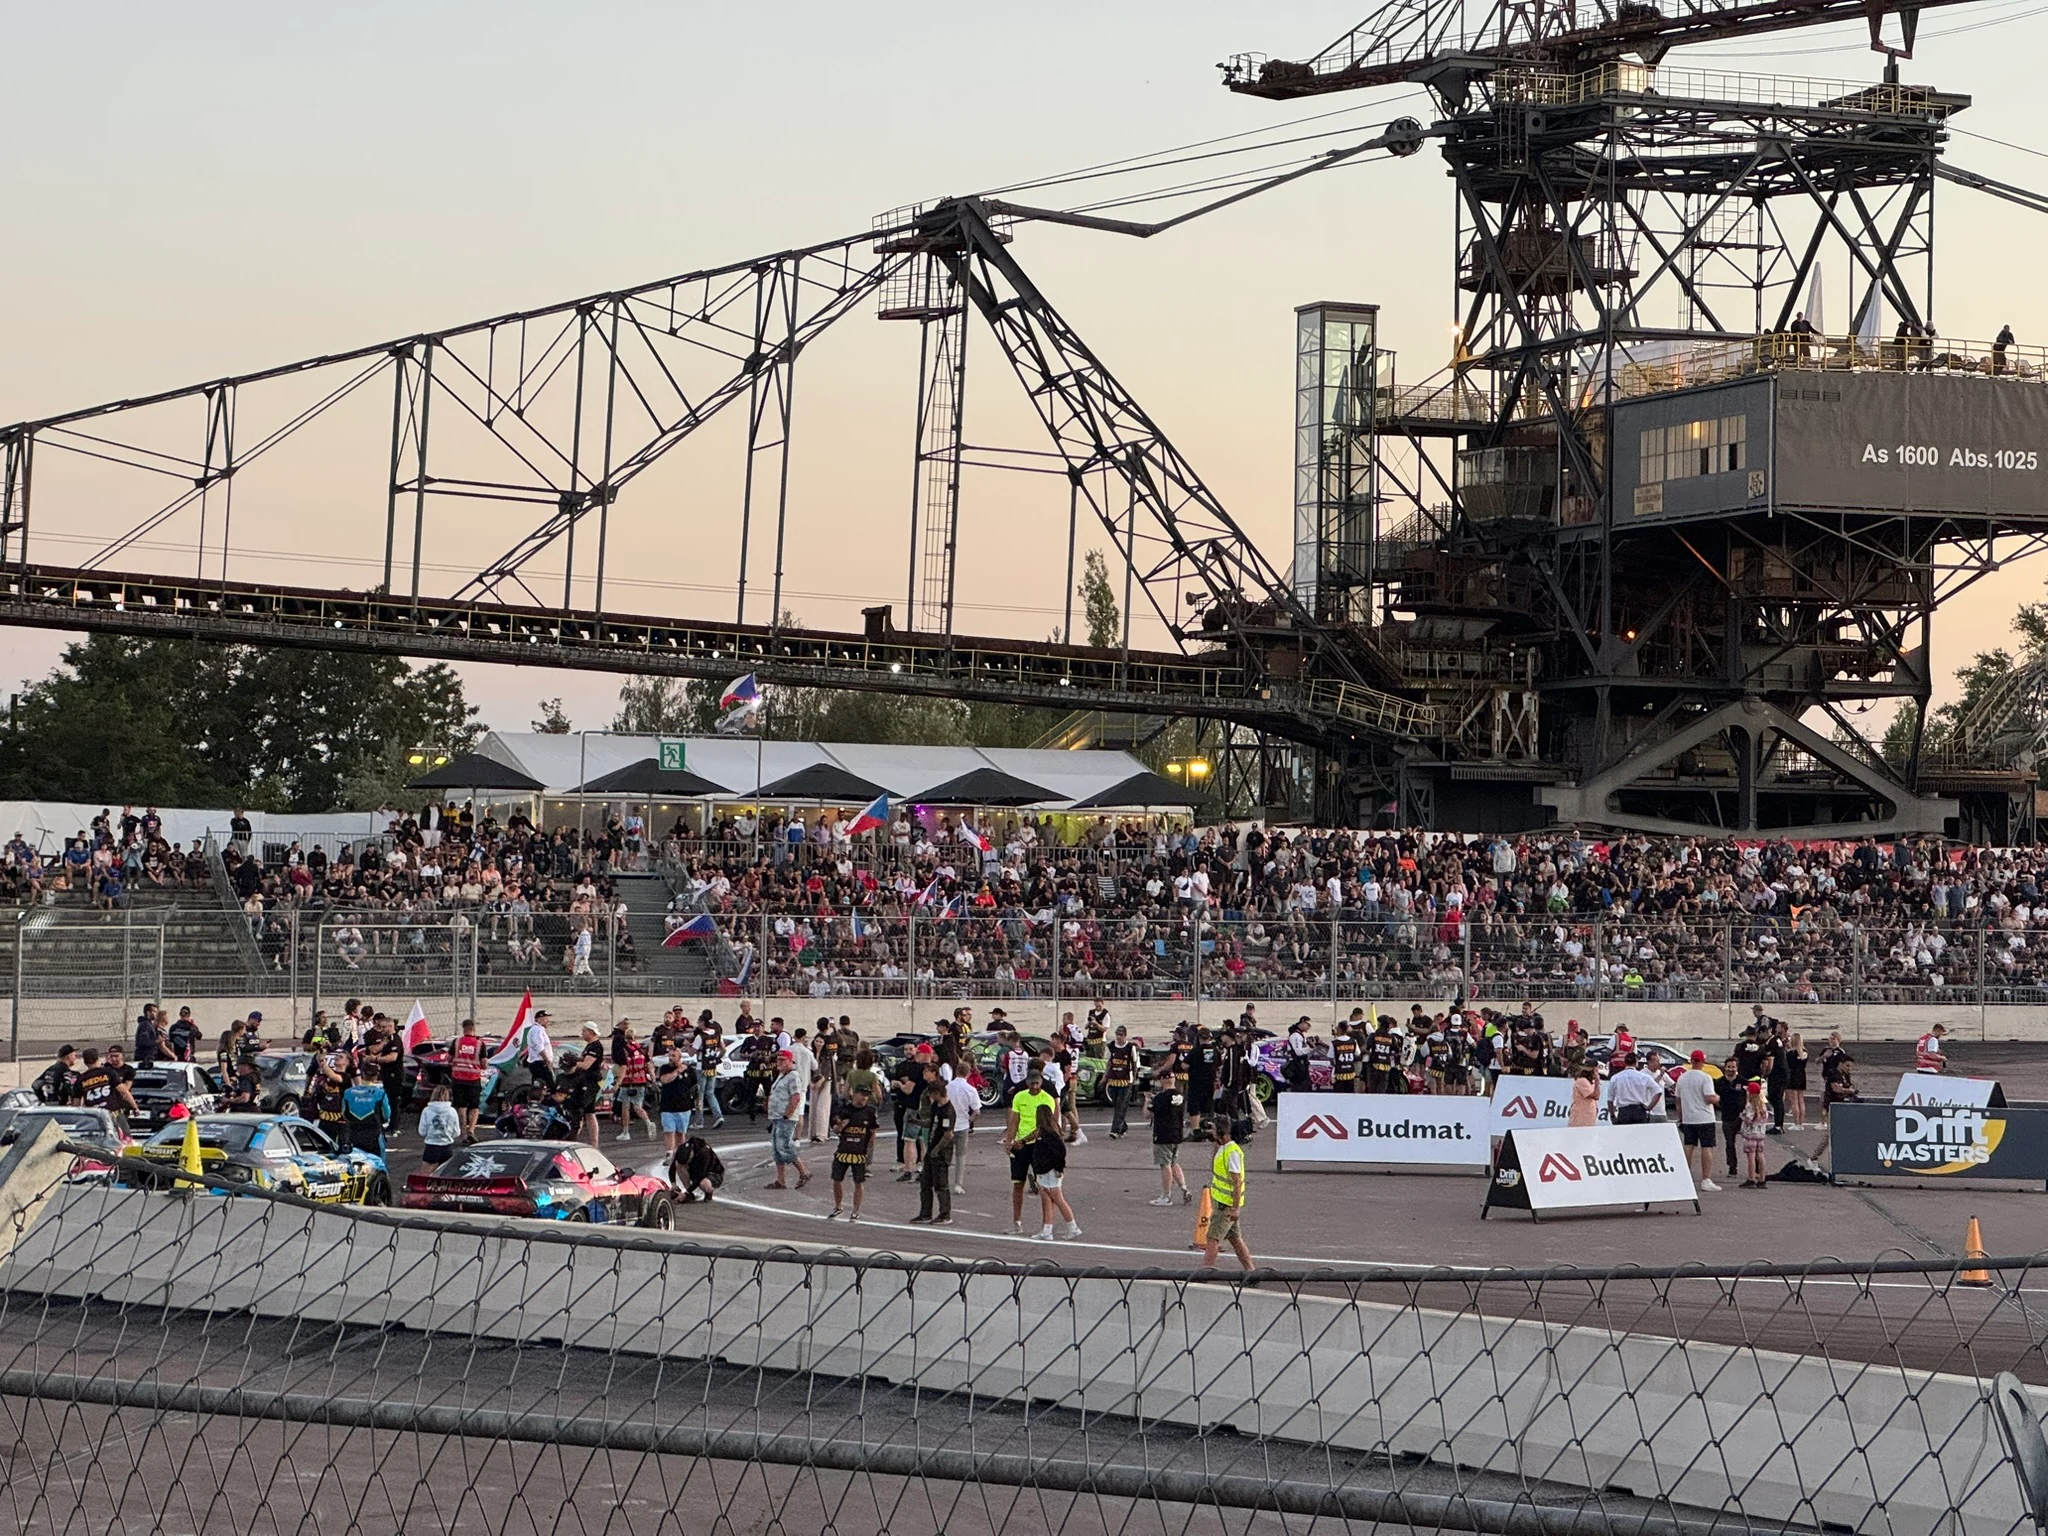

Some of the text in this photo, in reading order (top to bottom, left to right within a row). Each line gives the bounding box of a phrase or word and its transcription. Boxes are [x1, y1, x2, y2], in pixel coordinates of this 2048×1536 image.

[1861, 443, 1890, 464] As
[1895, 445, 1939, 466] 1600
[86, 1085, 112, 1101] 436
[1357, 1118, 1473, 1140] Budmat.
[1895, 1108, 1988, 1145] Drift
[1877, 1142, 1990, 1164] MASTERS
[1582, 1153, 1675, 1177] Budmat.
